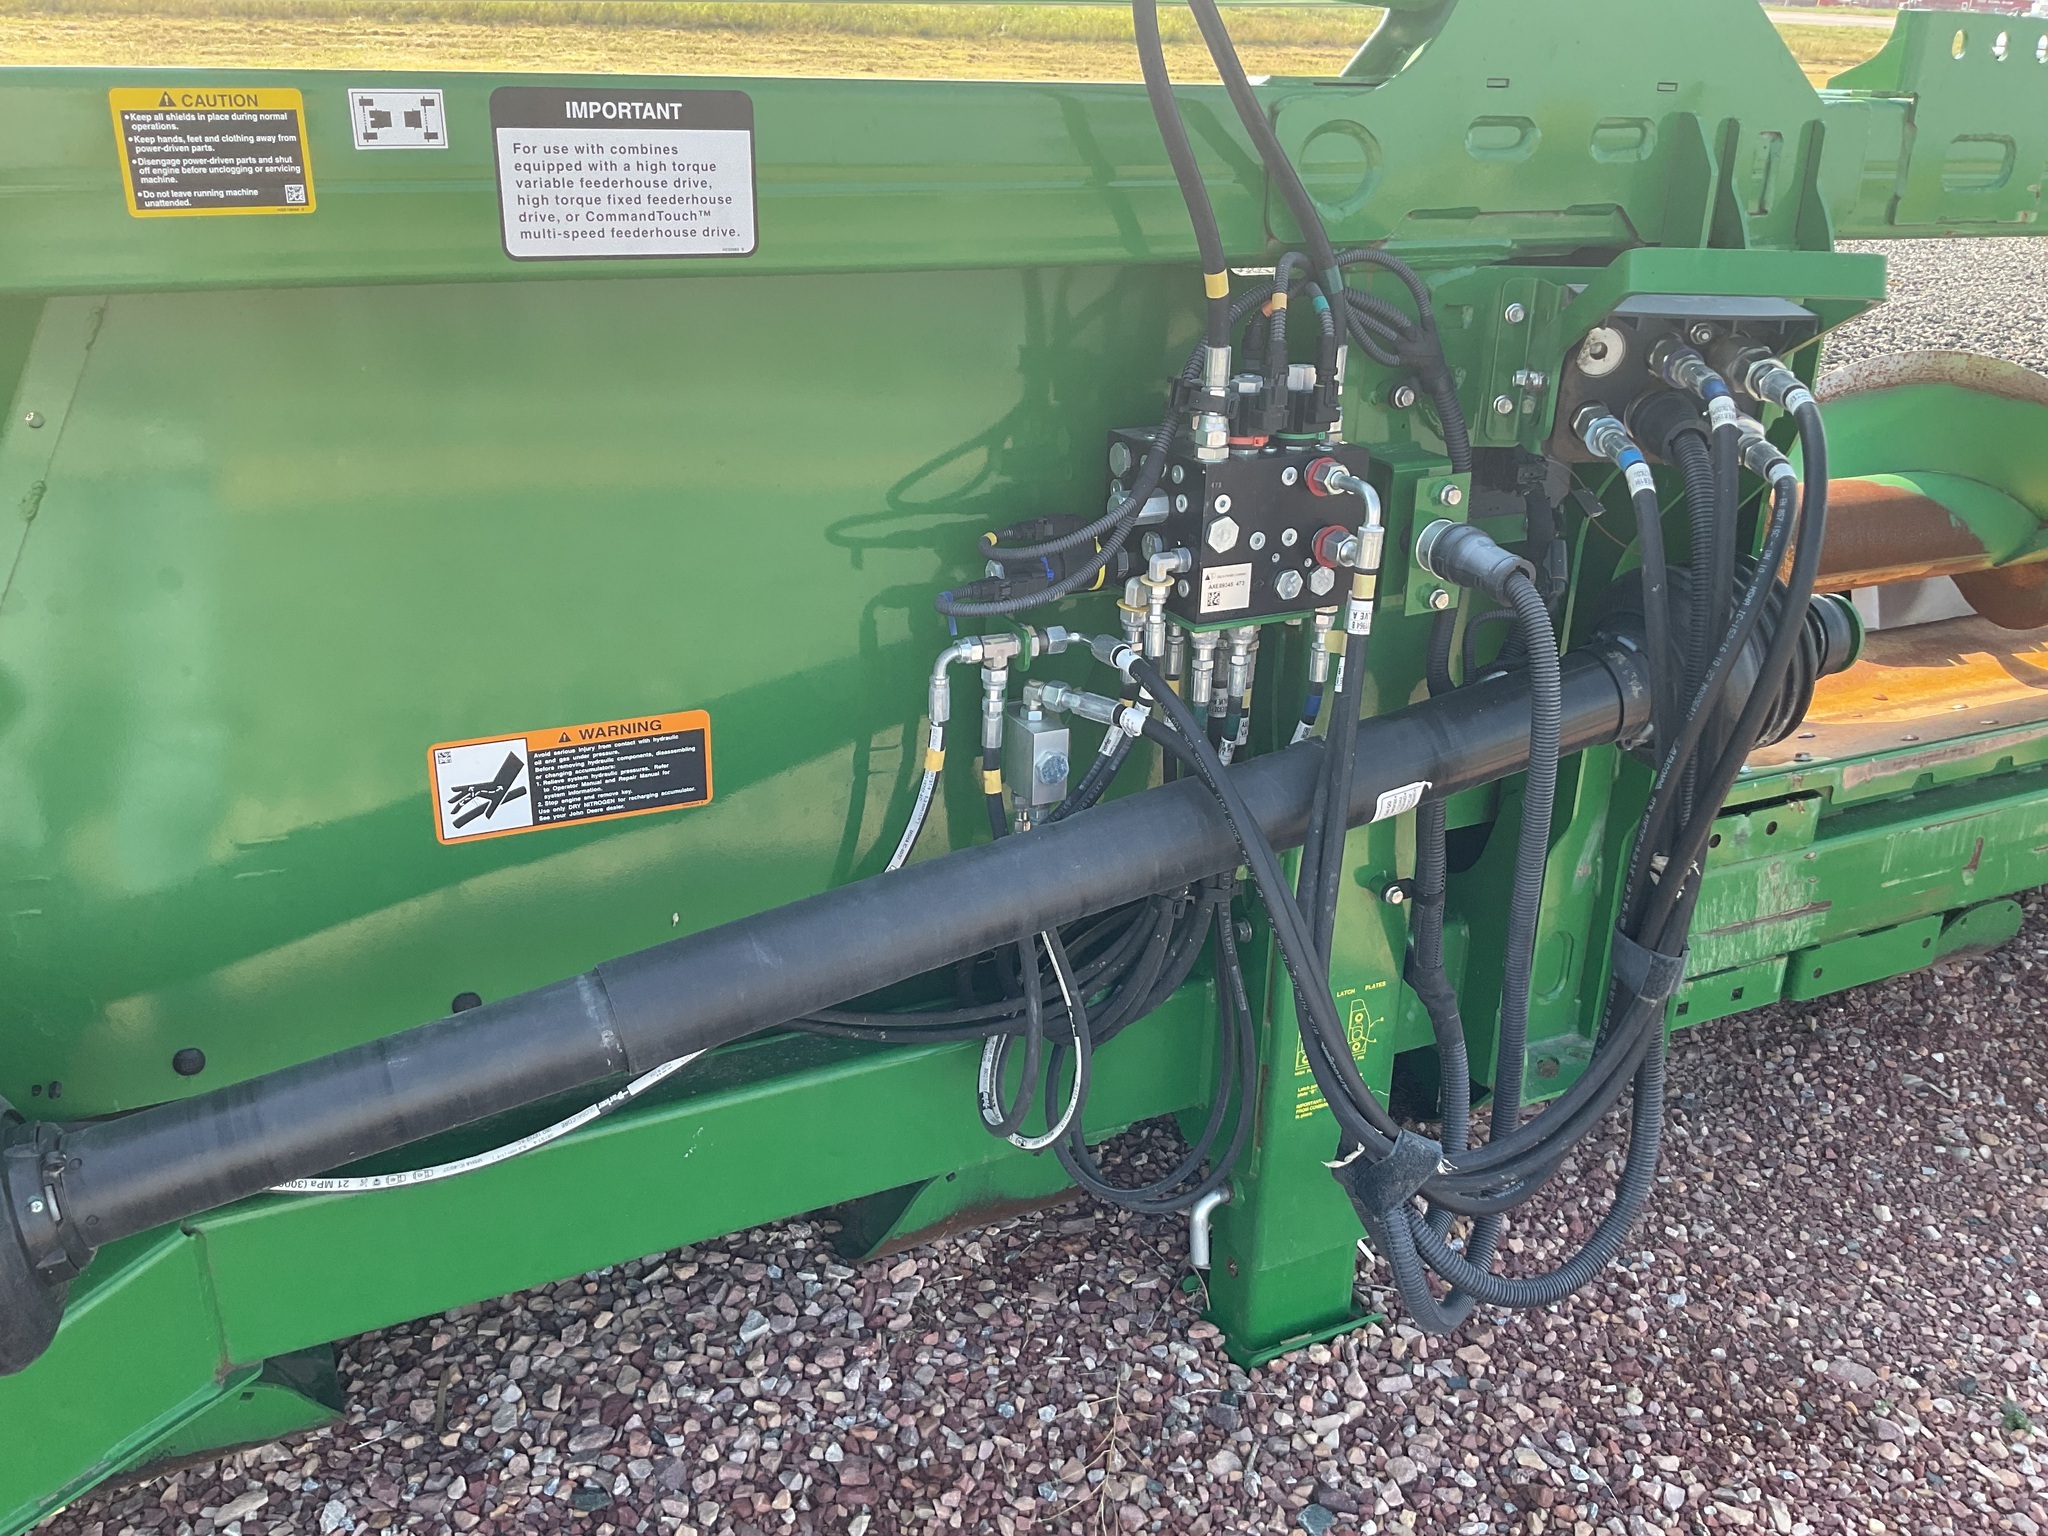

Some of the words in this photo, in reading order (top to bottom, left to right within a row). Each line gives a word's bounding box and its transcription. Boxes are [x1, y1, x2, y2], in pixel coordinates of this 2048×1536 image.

[181, 94, 258, 108] CAUTION
[565, 101, 682, 120] IMPORTANT
[130, 113, 152, 122] Keep
[207, 113, 229, 122] place
[231, 113, 258, 122] during
[131, 122, 179, 132] operations.
[134, 136, 156, 144] Keep
[157, 135, 186, 143] hands,
[186, 135, 202, 143] feet
[222, 134, 254, 144] clothing
[256, 135, 276, 144] away
[278, 134, 296, 142] from
[135, 144, 189, 154] power-driven
[192, 144, 215, 154] parts.
[512, 142, 537, 155] For
[544, 145, 568, 155] use
[574, 143, 604, 155] with
[610, 143, 678, 155] combines
[137, 158, 180, 166] Disengage
[183, 157, 234, 166] power-driven
[236, 157, 256, 165] parts
[514, 160, 582, 175] equipped
[588, 160, 618, 172] with
[623, 163, 631, 172] a
[636, 160, 667, 174] high
[672, 161, 717, 175] torque
[152, 167, 180, 176] engine
[181, 166, 207, 174] before
[209, 166, 253, 174] unclogging
[265, 165, 300, 174] servicing
[516, 178, 574, 189] variable
[580, 178, 668, 189] feederhouse
[673, 178, 712, 191] drive,
[143, 190, 155, 198] Do
[194, 189, 224, 198] running
[226, 188, 258, 196] machine
[145, 199, 192, 207] unattended.
[517, 194, 549, 208] high
[554, 195, 602, 208] torque
[607, 194, 642, 205] fixed
[647, 194, 732, 205] feederhouse
[519, 211, 560, 224] drive,
[565, 213, 580, 223] or
[520, 228, 606, 241] multi-speed
[610, 227, 697, 238] feederhouse
[702, 227, 740, 238] drive.
[578, 720, 662, 740] WARNING
[554, 748, 576, 756] serious
[653, 735, 679, 743] hydraulic
[588, 757, 614, 766] hydraulic
[617, 752, 654, 761] components,
[656, 746, 696, 756] disassembling
[592, 750, 620, 758] pressure.
[575, 765, 615, 774] accumulators:
[620, 767, 650, 775] pressures.
[544, 792, 565, 800] system
[568, 787, 603, 796] information.
[552, 783, 578, 791] Operator
[584, 799, 615, 808] NITROGEN
[629, 792, 658, 801] recharging
[661, 786, 696, 796] accumulator.
[1336, 988, 1356, 998] LATCH
[1364, 980, 1387, 991] PLATES
[598, 1090, 626, 1109] Parker
[311, 1180, 333, 1188] MPa
[338, 1180, 349, 1188] 21
